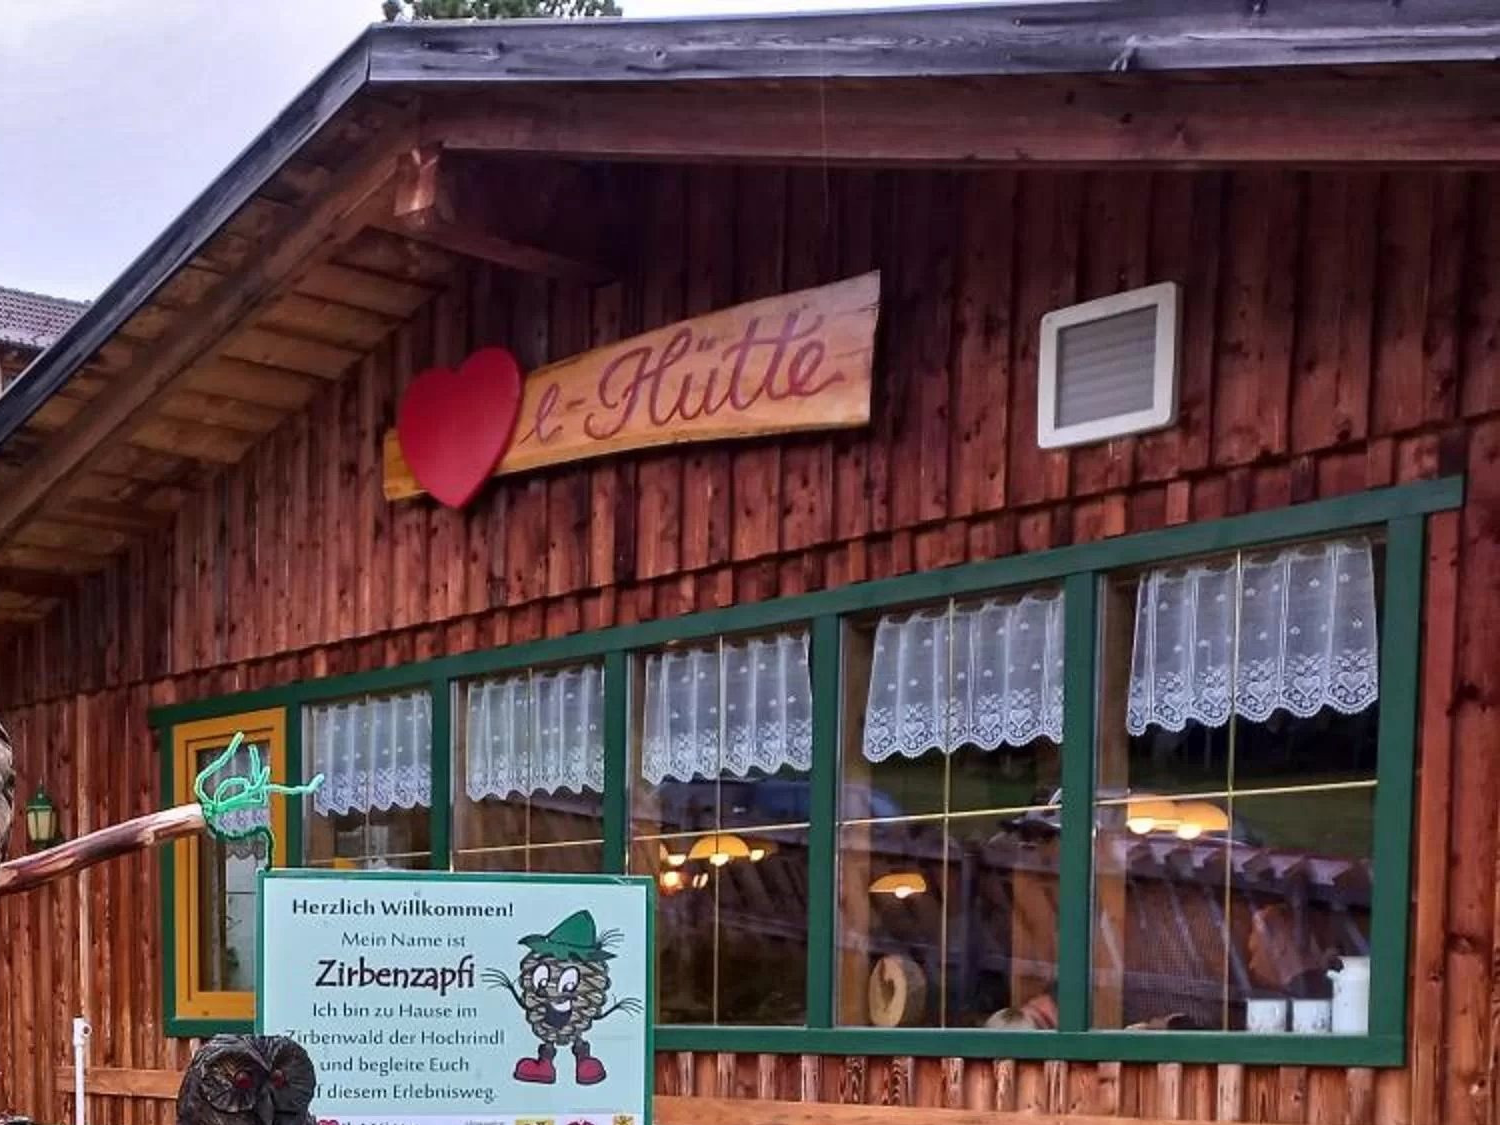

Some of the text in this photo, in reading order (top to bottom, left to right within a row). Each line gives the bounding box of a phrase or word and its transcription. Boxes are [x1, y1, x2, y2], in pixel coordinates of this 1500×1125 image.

[293, 899, 514, 918] Herzlich Willkommen!
[341, 931, 466, 948] Mein Name ist
[315, 954, 475, 997] Zirbenzapfi
[312, 1002, 478, 1019] Ich bin zu Hause im
[389, 1030, 417, 1045] der
[421, 1030, 505, 1046] Hochrindl
[320, 1056, 470, 1077] und begleite Euch
[327, 1084, 387, 1099] diesem
[393, 1084, 498, 1104] Erlebnisweg.
